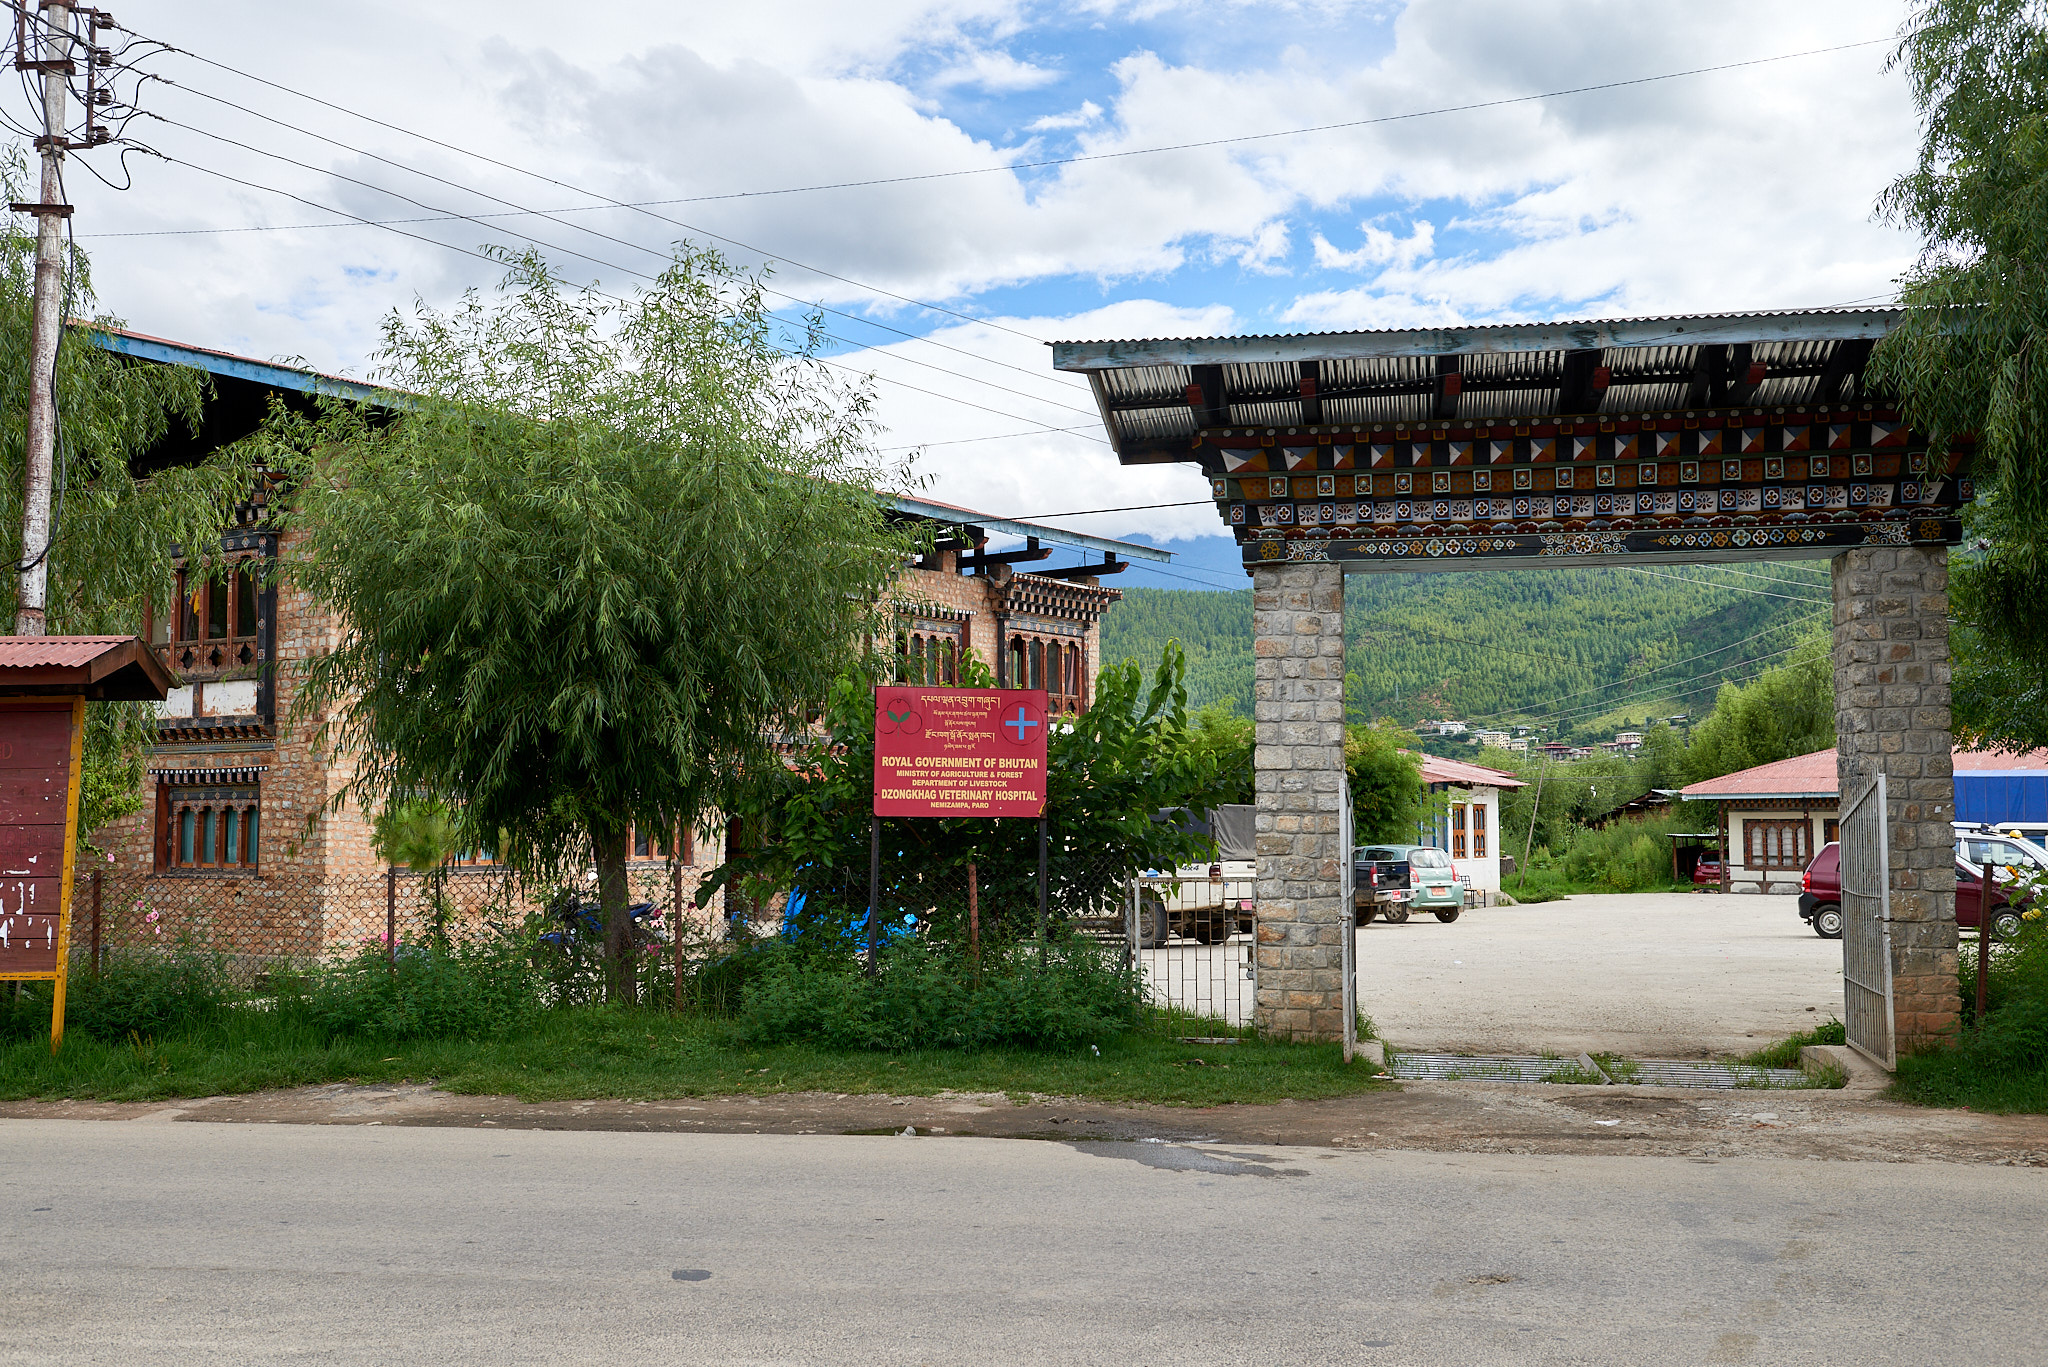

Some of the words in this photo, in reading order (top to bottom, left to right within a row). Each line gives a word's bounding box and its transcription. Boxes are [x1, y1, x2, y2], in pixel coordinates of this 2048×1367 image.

[881, 756, 913, 767] ROYAL
[915, 757, 982, 768] GOVERNMENT
[983, 758, 997, 768] OF
[999, 758, 1038, 769] BHUTAN
[941, 770, 989, 778] AGRICULTURE
[912, 779, 958, 787] DEPARTMENT
[881, 788, 938, 799] DZONGKHAG
[939, 789, 995, 800] VETERINARY
[995, 790, 1038, 801] HOSPITAL
[930, 801, 972, 809] NEMIZAMPA,
